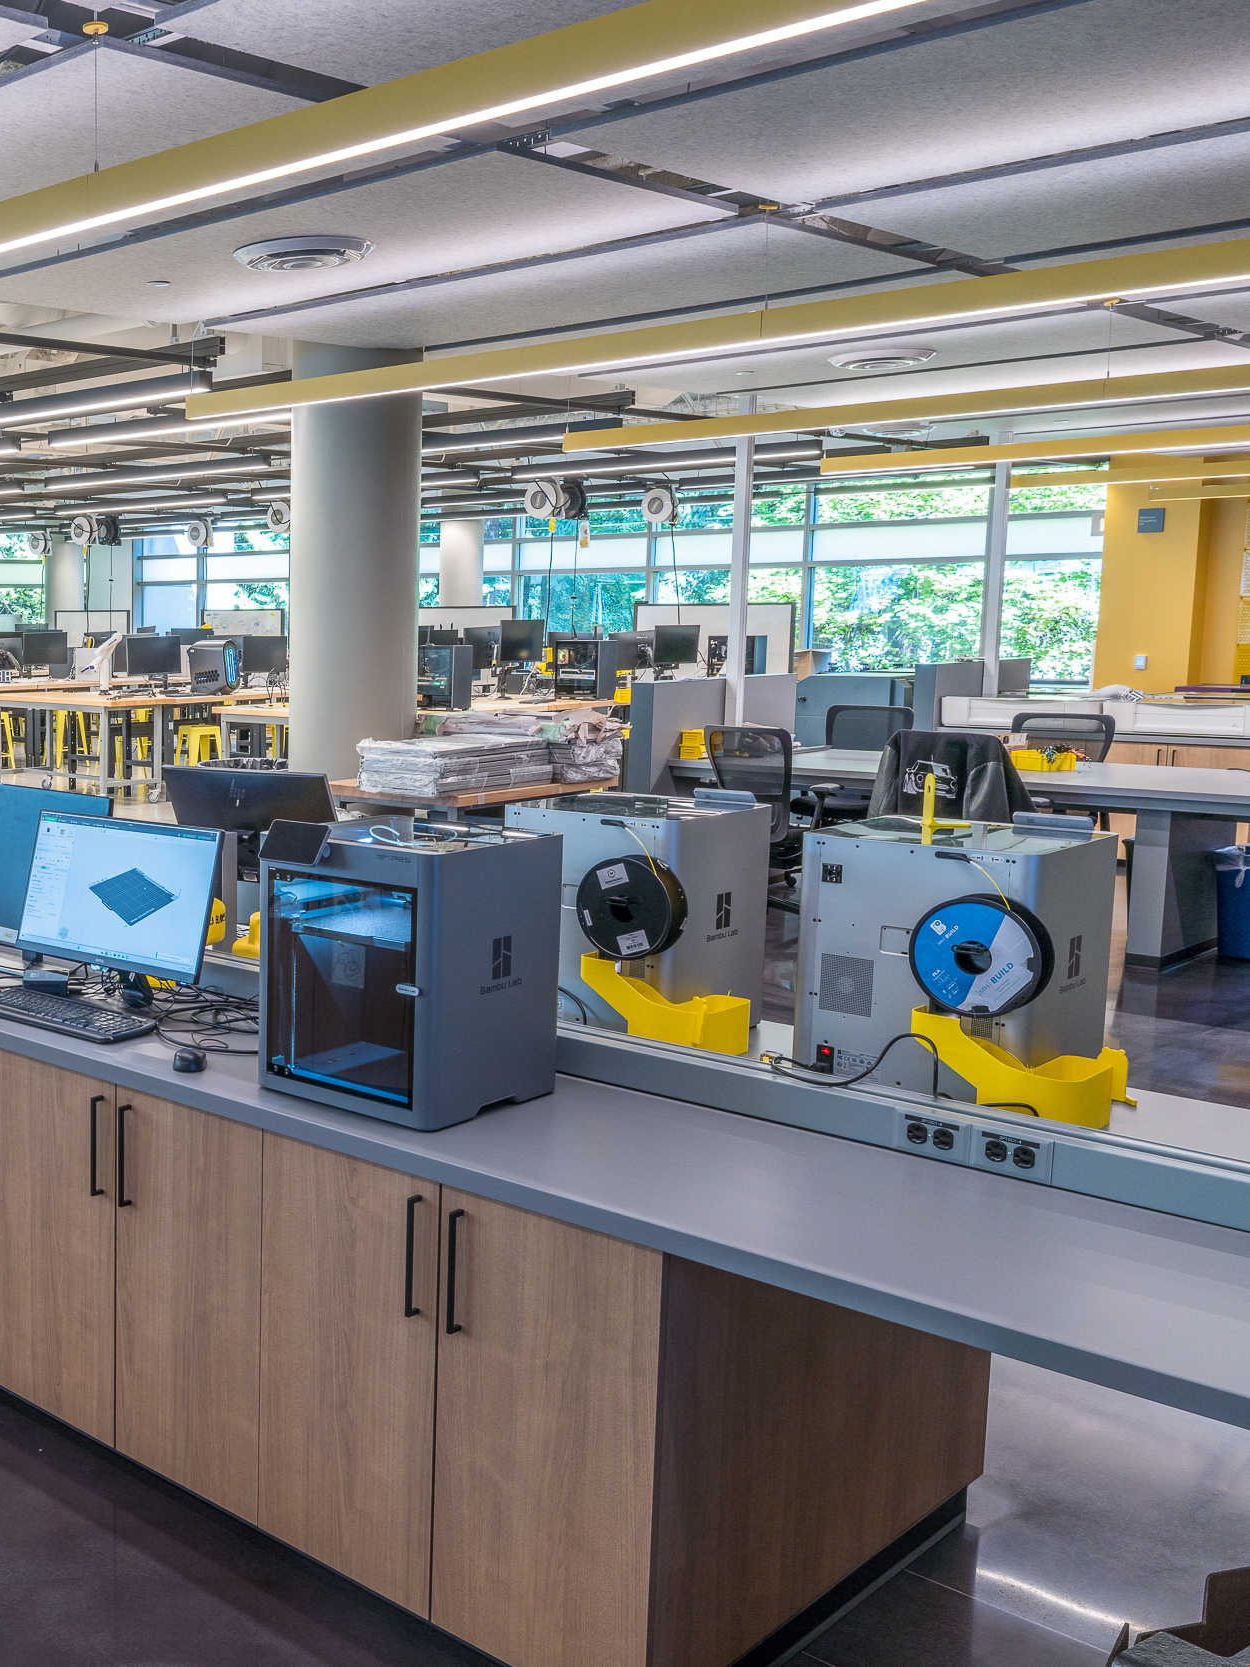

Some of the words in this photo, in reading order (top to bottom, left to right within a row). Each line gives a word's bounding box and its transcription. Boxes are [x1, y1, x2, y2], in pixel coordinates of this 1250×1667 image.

[706, 932, 726, 942] Bambu
[728, 929, 738, 937] Lab
[945, 925, 958, 939] BUILD
[932, 968, 941, 977] PLA
[990, 962, 1014, 984] BUILD
[480, 982, 507, 995] Bambu
[508, 977, 522, 988] Lab
[1060, 981, 1076, 994] Bambu
[1077, 978, 1086, 987] Lab
